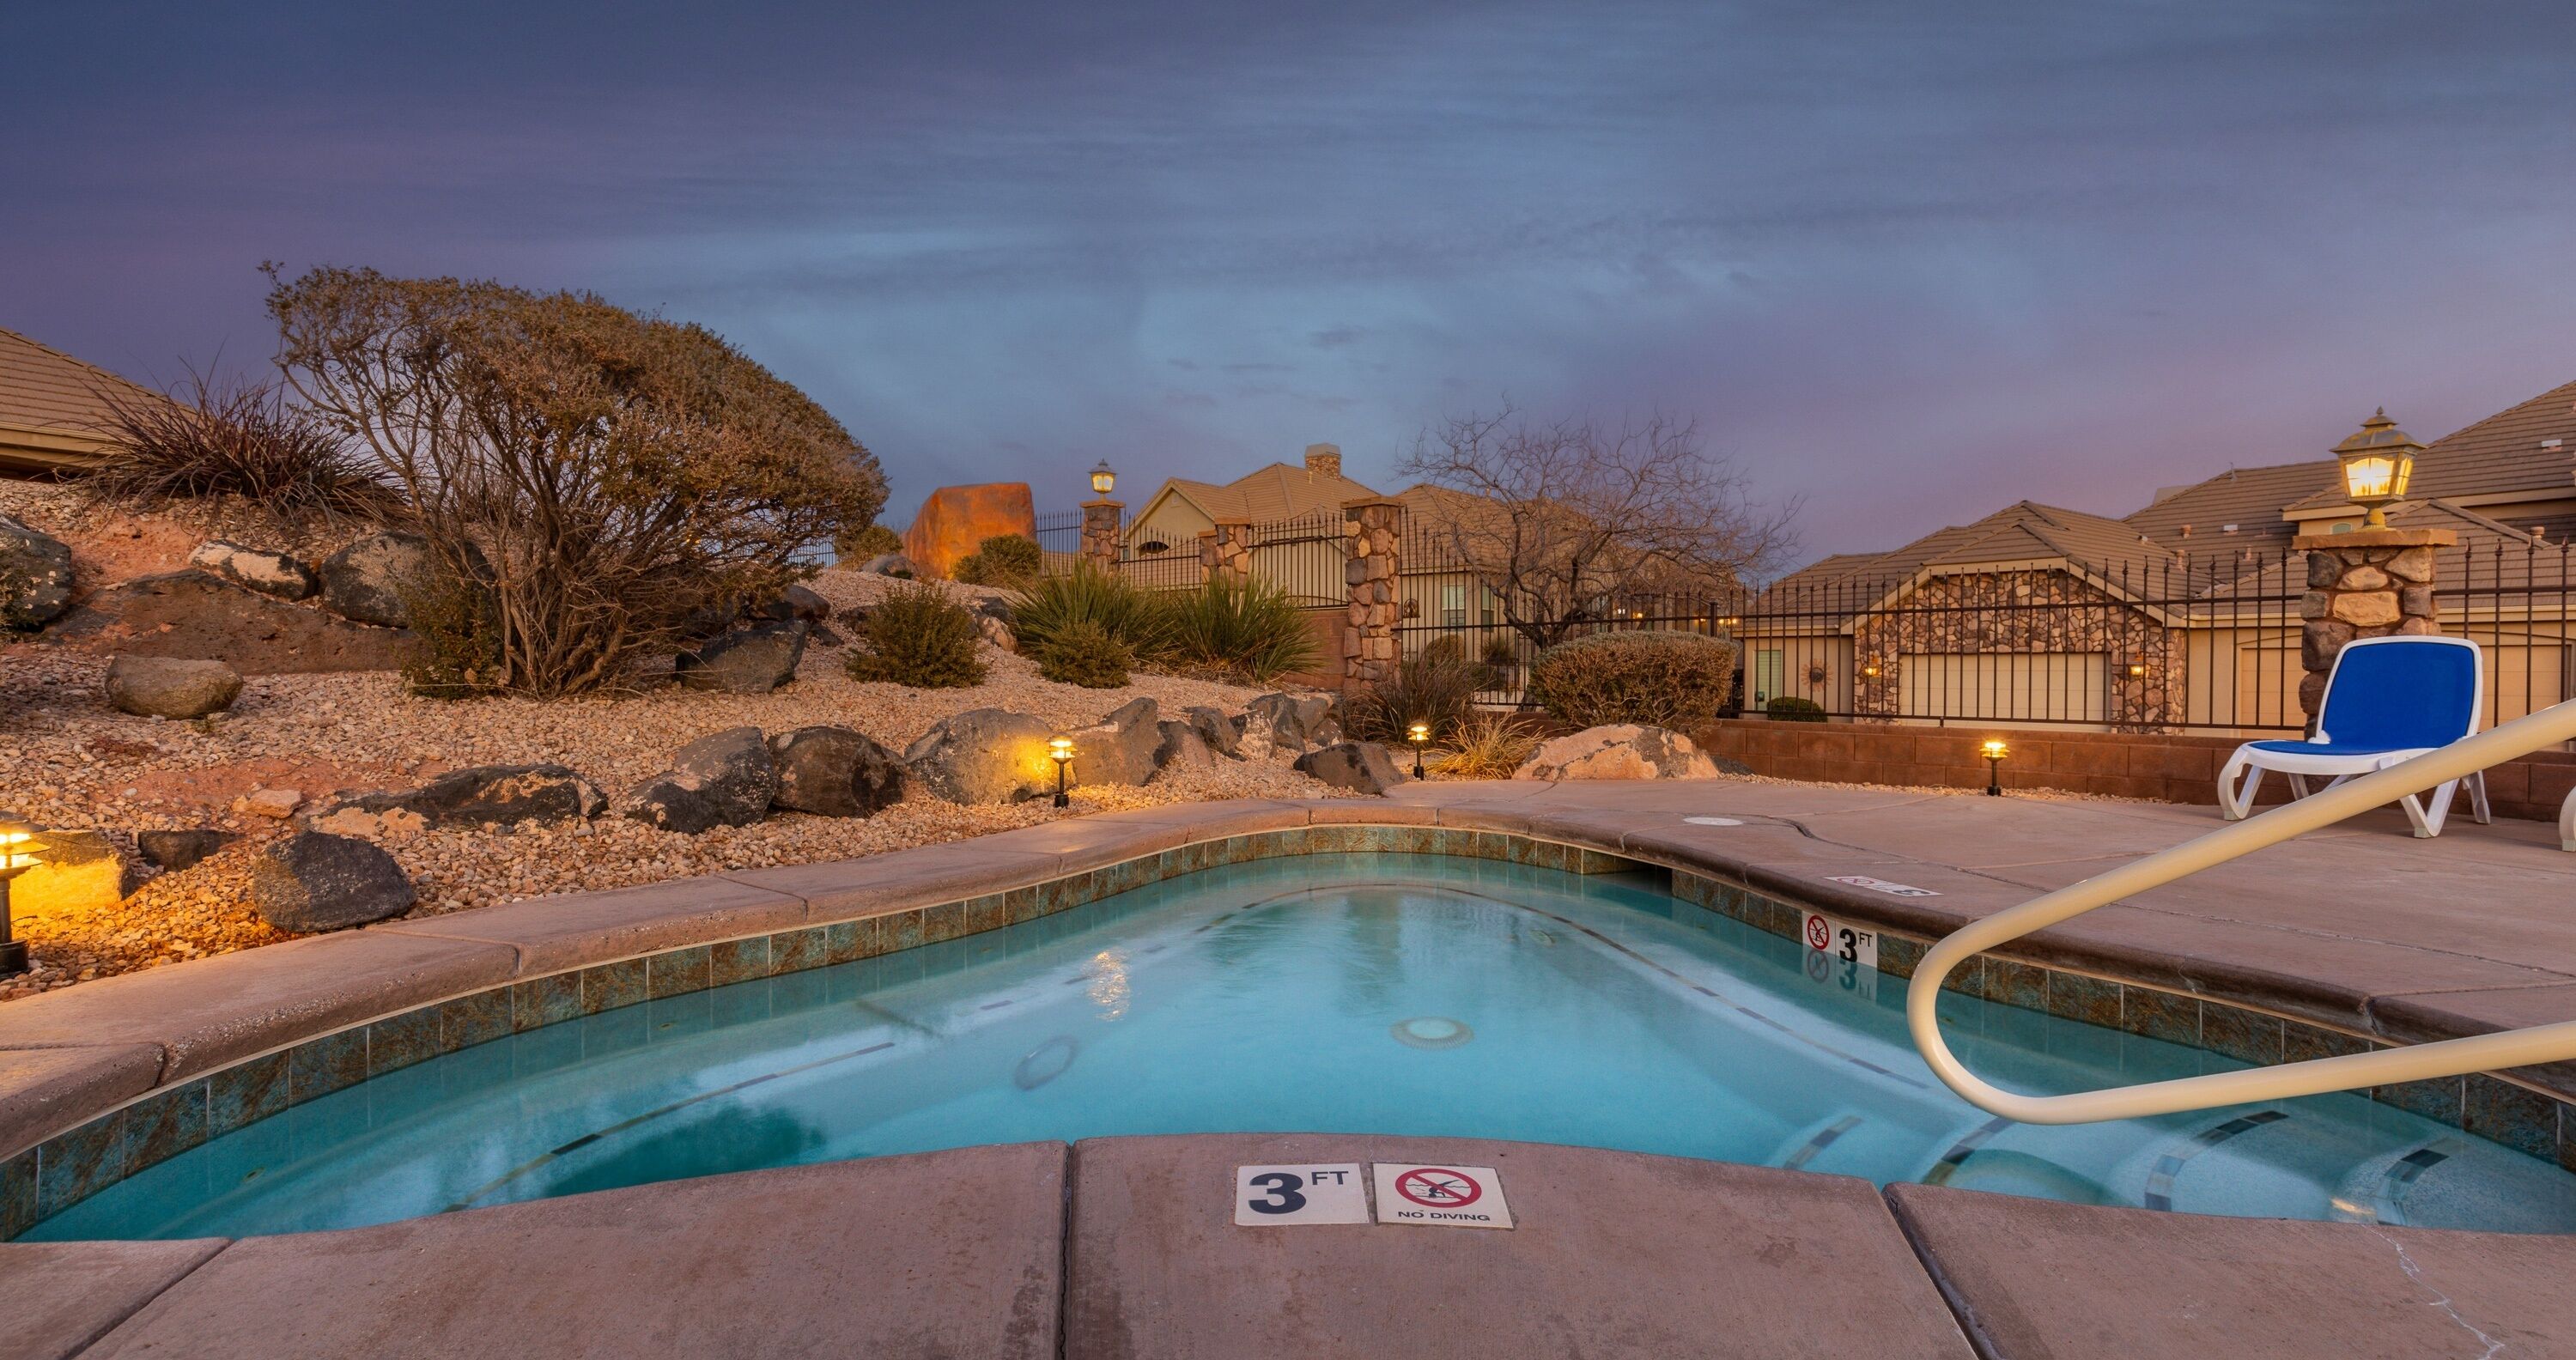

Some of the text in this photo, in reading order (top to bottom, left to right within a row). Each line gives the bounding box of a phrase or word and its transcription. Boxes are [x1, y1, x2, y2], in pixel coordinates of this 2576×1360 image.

[1839, 928, 1873, 962] 3 FT
[1249, 1171, 1349, 1214] 3 FT
[1398, 1211, 1491, 1222] NO DIVING
